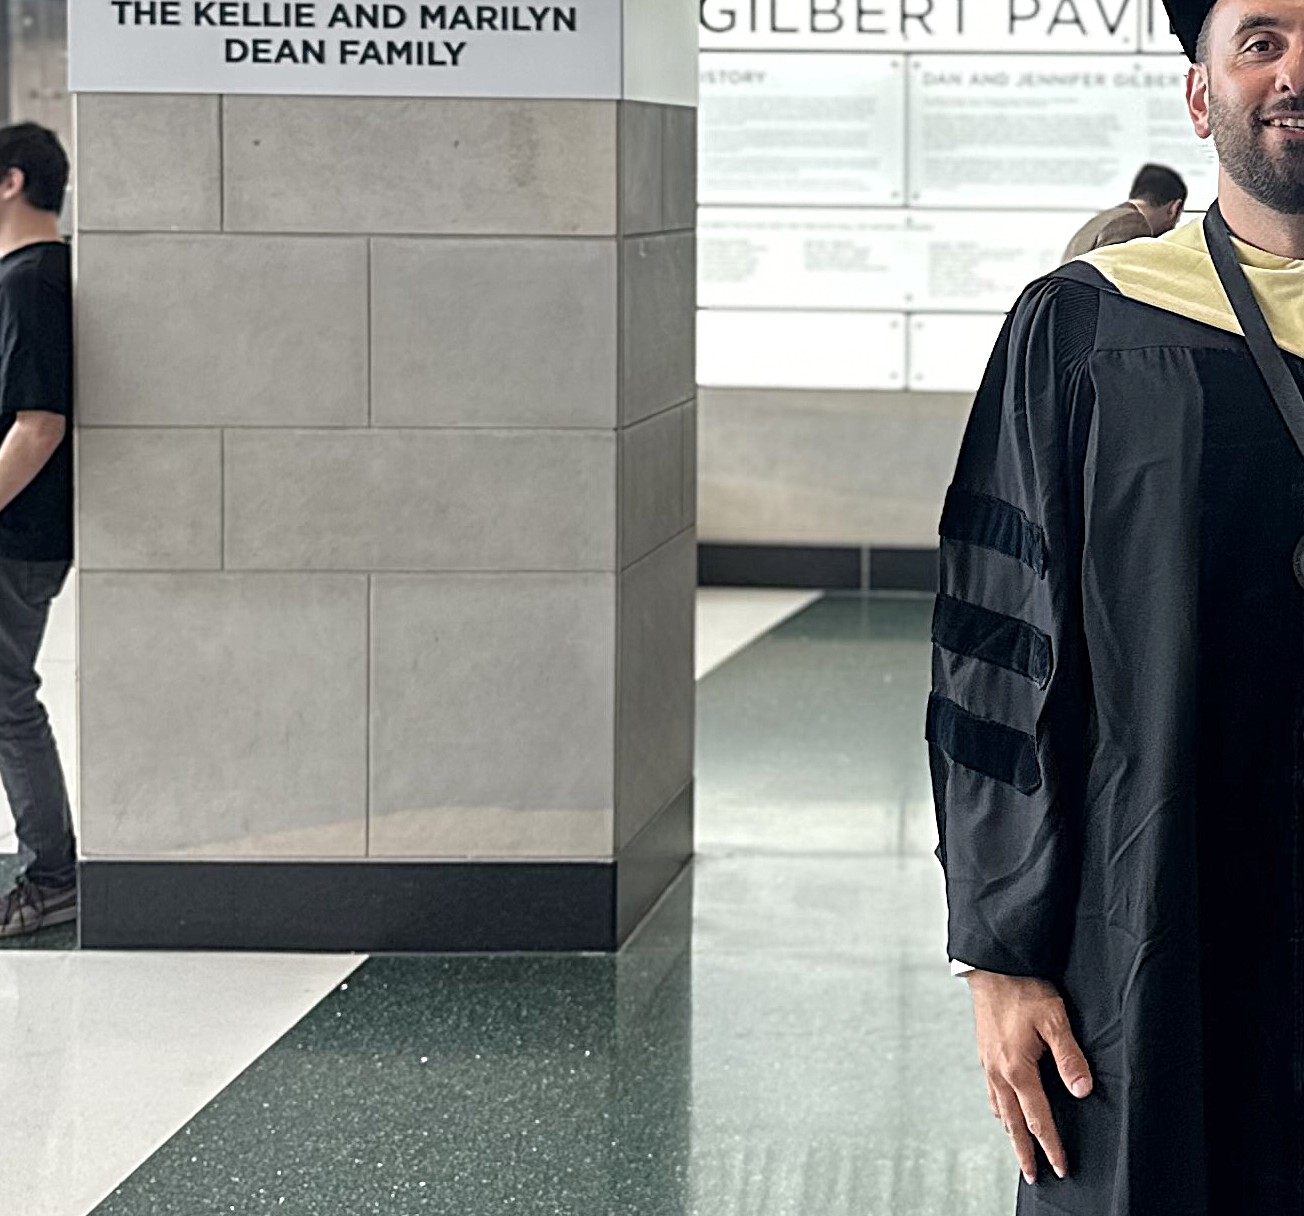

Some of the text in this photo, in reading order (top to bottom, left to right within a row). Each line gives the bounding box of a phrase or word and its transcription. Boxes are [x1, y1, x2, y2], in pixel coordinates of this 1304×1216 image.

[111, 0, 577, 32] THE KELLIE AND MARILYN
[224, 39, 467, 67] DEAN FAMILY
[969, 72, 1009, 88] AND
[1112, 72, 1186, 88] GILBER
